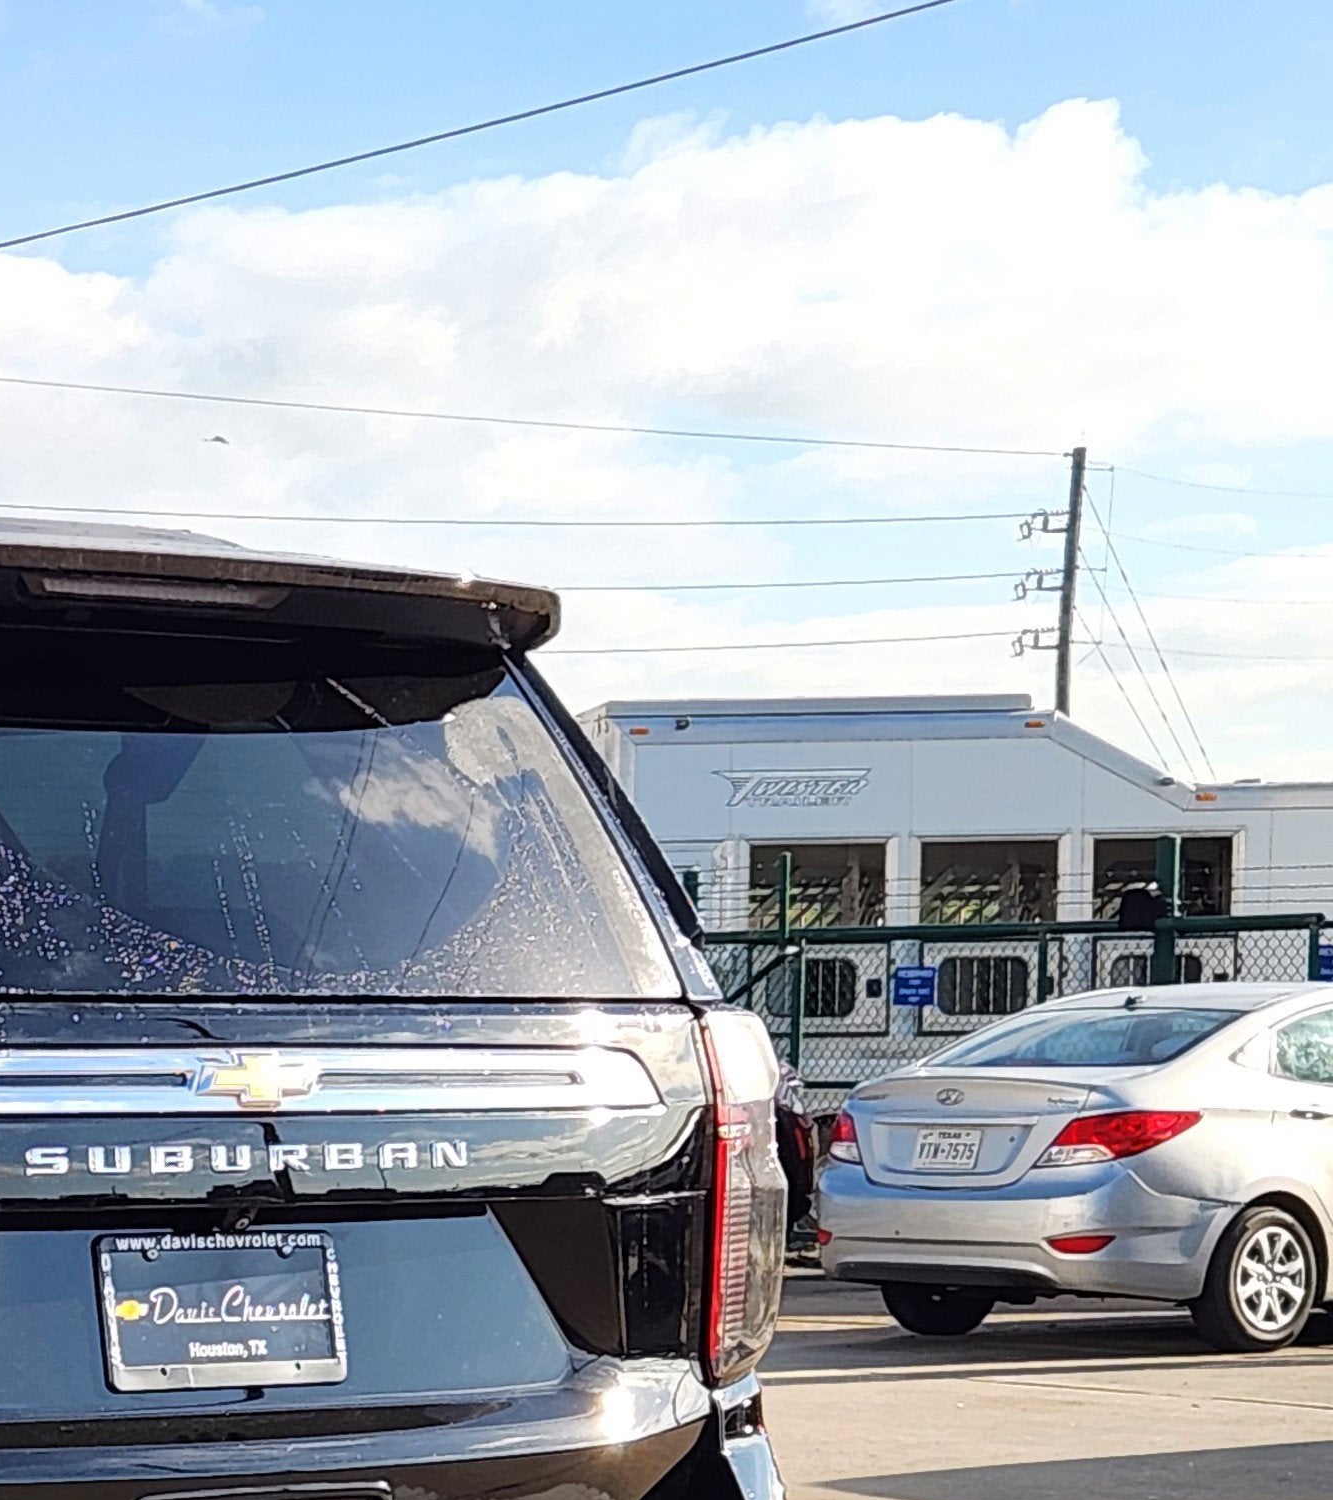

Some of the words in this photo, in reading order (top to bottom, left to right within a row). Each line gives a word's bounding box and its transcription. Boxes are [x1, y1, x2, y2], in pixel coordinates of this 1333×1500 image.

[24, 1139, 469, 1176] SUBURBAN
[150, 1286, 222, 1325] Davis
[220, 1284, 331, 1322] Chevrolet
[188, 1341, 249, 1359] Houston,
[248, 1339, 268, 1356] TX
